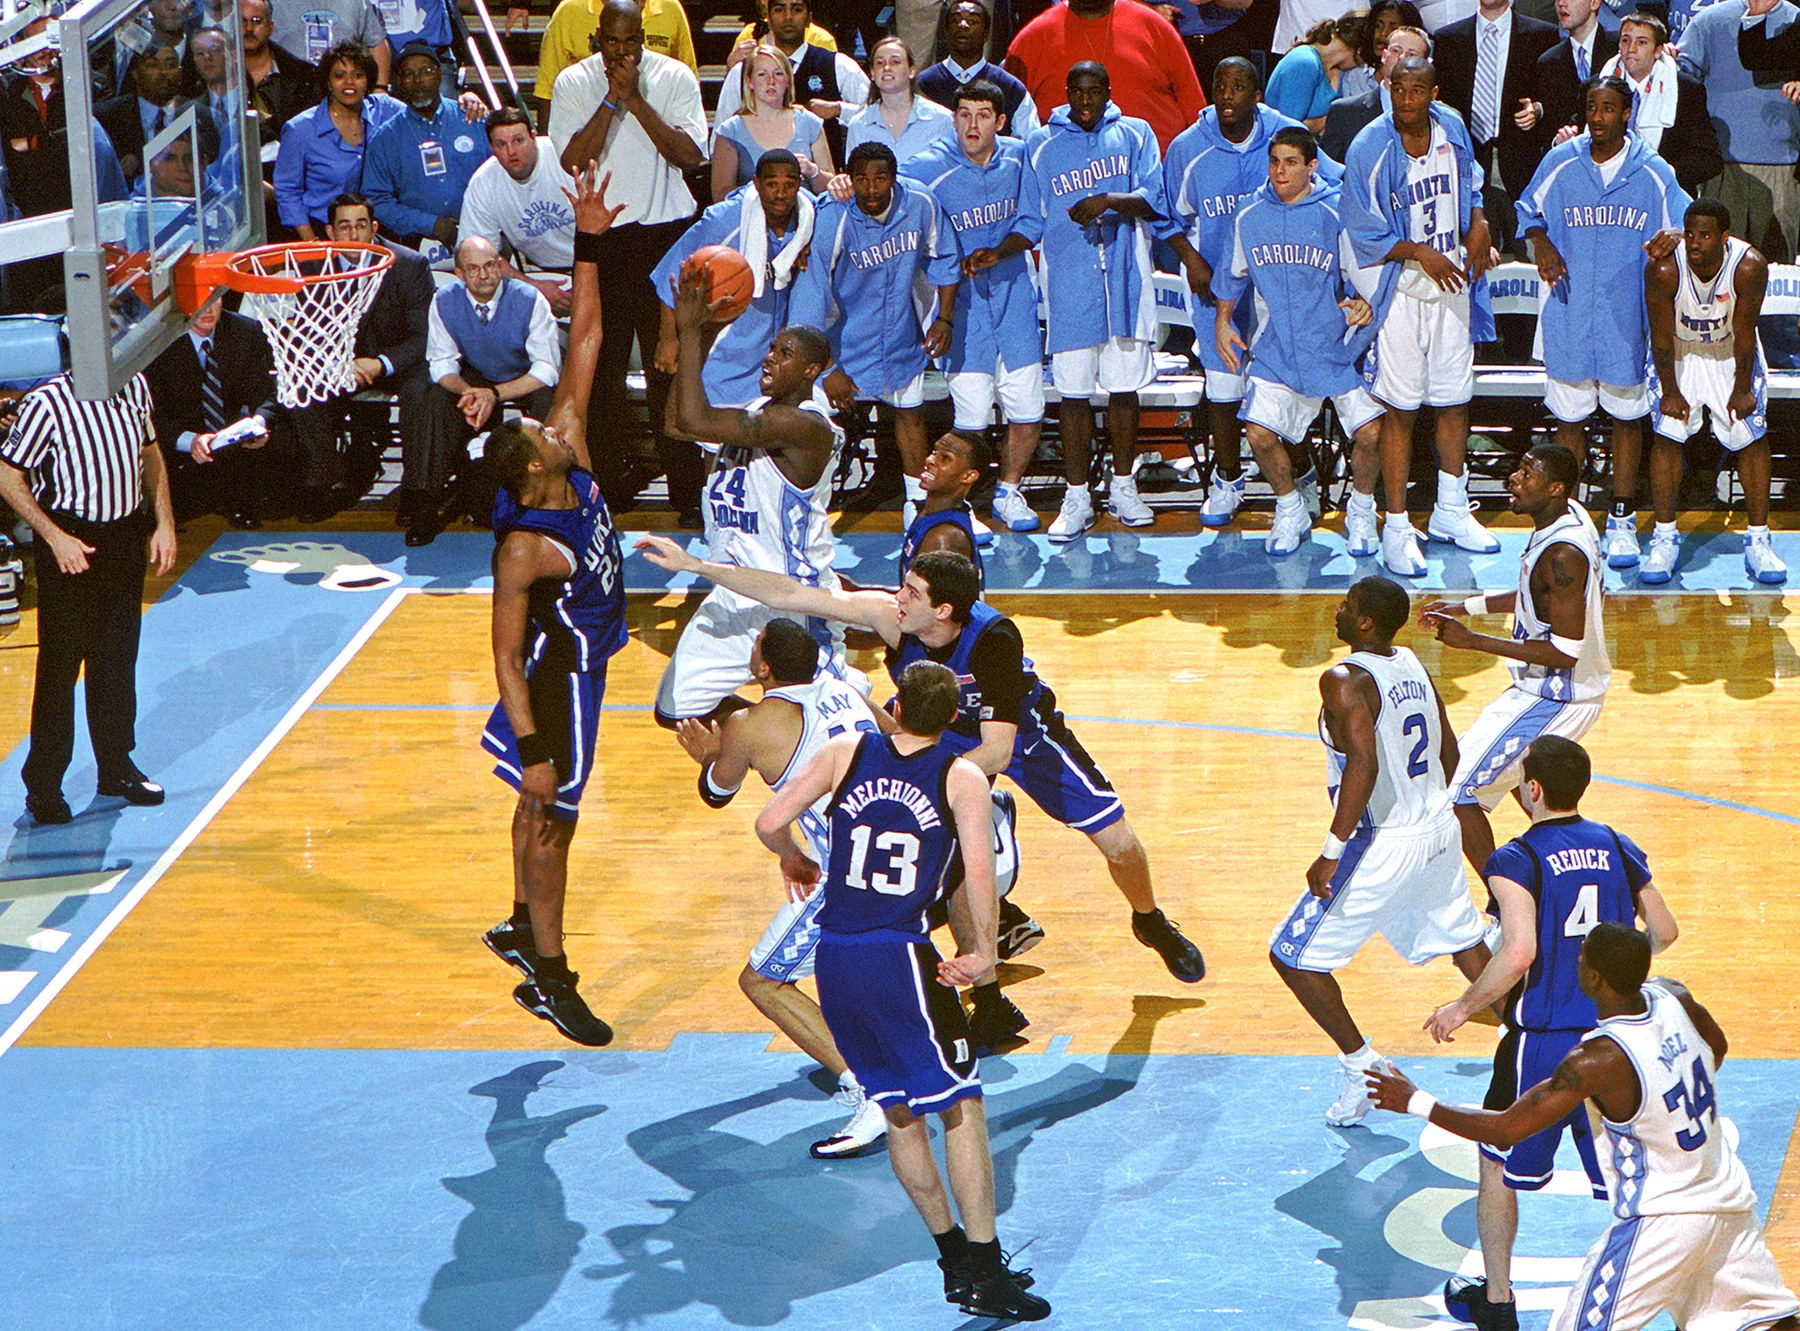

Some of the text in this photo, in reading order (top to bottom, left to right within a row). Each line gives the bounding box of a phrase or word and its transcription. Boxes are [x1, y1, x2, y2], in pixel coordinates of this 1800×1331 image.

[1423, 199, 1437, 236] 3
[1563, 205, 1649, 232] CAROLINA
[850, 230, 921, 270] CAROLIN
[1251, 243, 1335, 273] CAROLINA
[709, 461, 746, 509] 24
[816, 693, 853, 720] MAY
[1388, 680, 1427, 709] FELTON
[1403, 712, 1429, 779] 2
[839, 777, 942, 832] MELCHIONNI
[845, 824, 920, 896] 13
[1545, 848, 1611, 877] REDICK
[1564, 883, 1602, 944] 4
[1657, 1032, 1688, 1072] NOEL
[1662, 1054, 1716, 1152] 34
